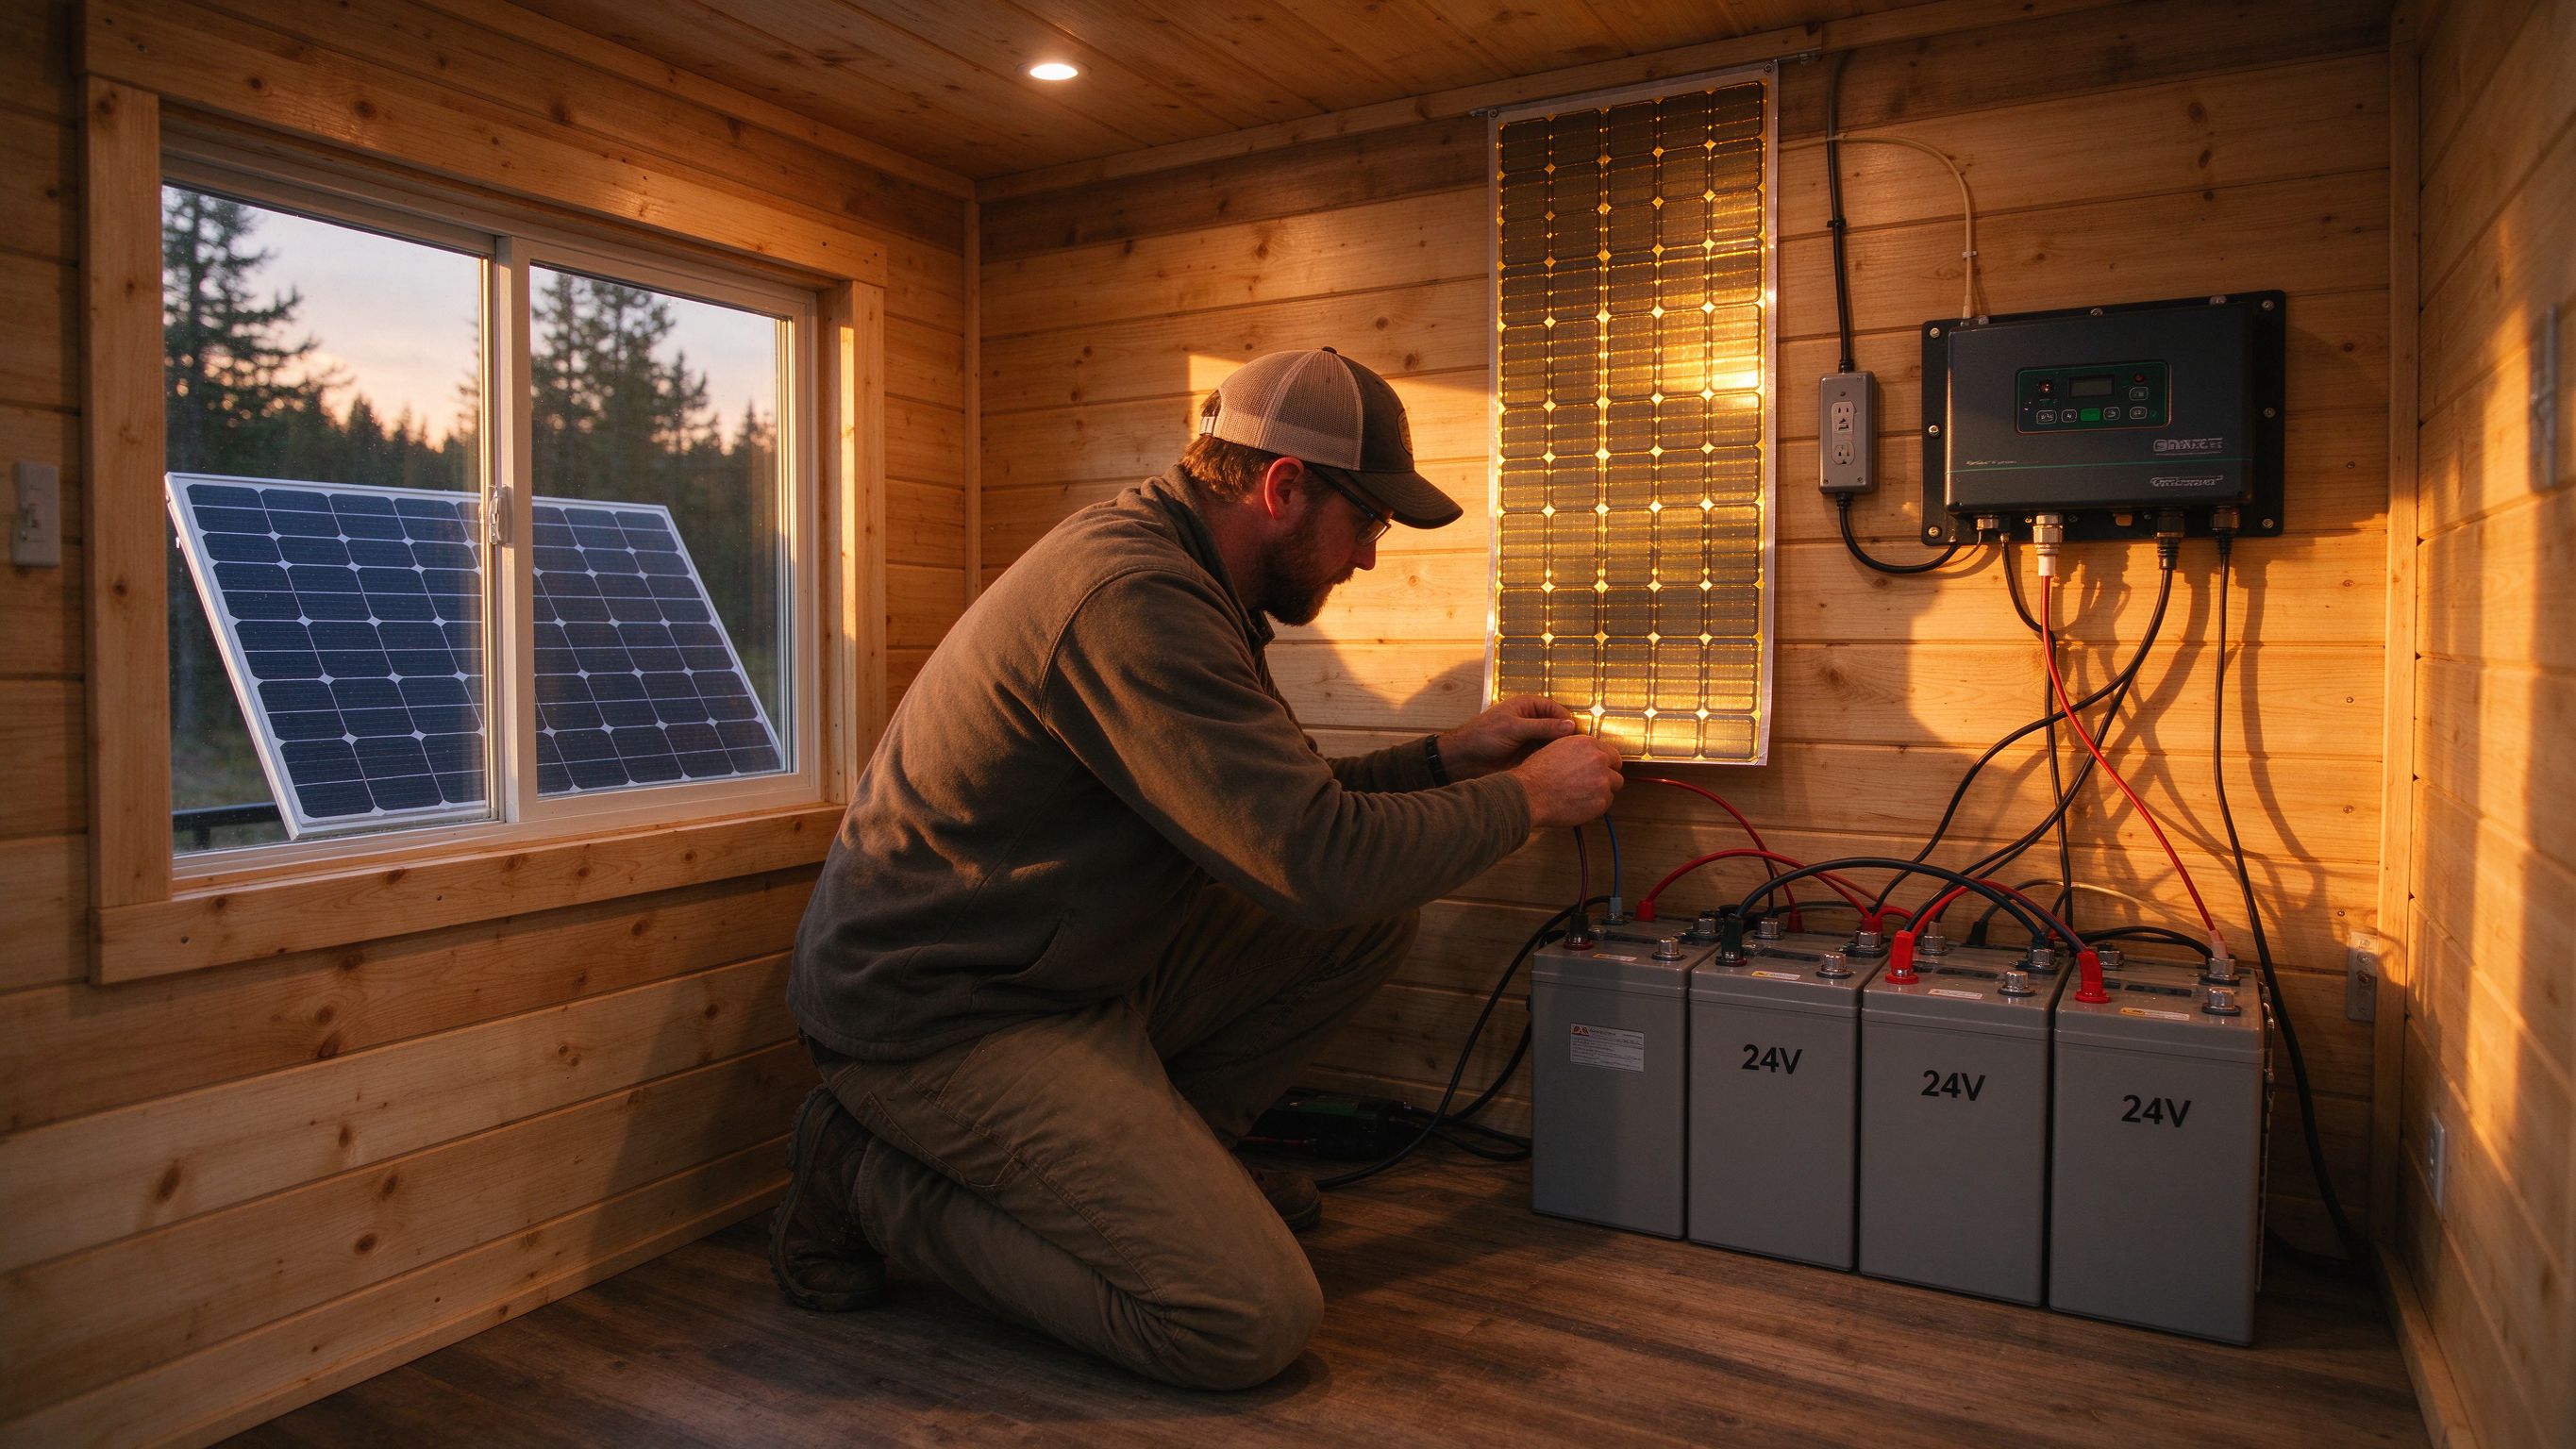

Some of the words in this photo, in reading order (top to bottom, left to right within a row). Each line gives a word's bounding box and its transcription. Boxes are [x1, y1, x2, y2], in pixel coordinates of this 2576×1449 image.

[1741, 1043, 1803, 1075] 24V
[1920, 1069, 1986, 1102] 24V
[2120, 1094, 2192, 1128] 24V
